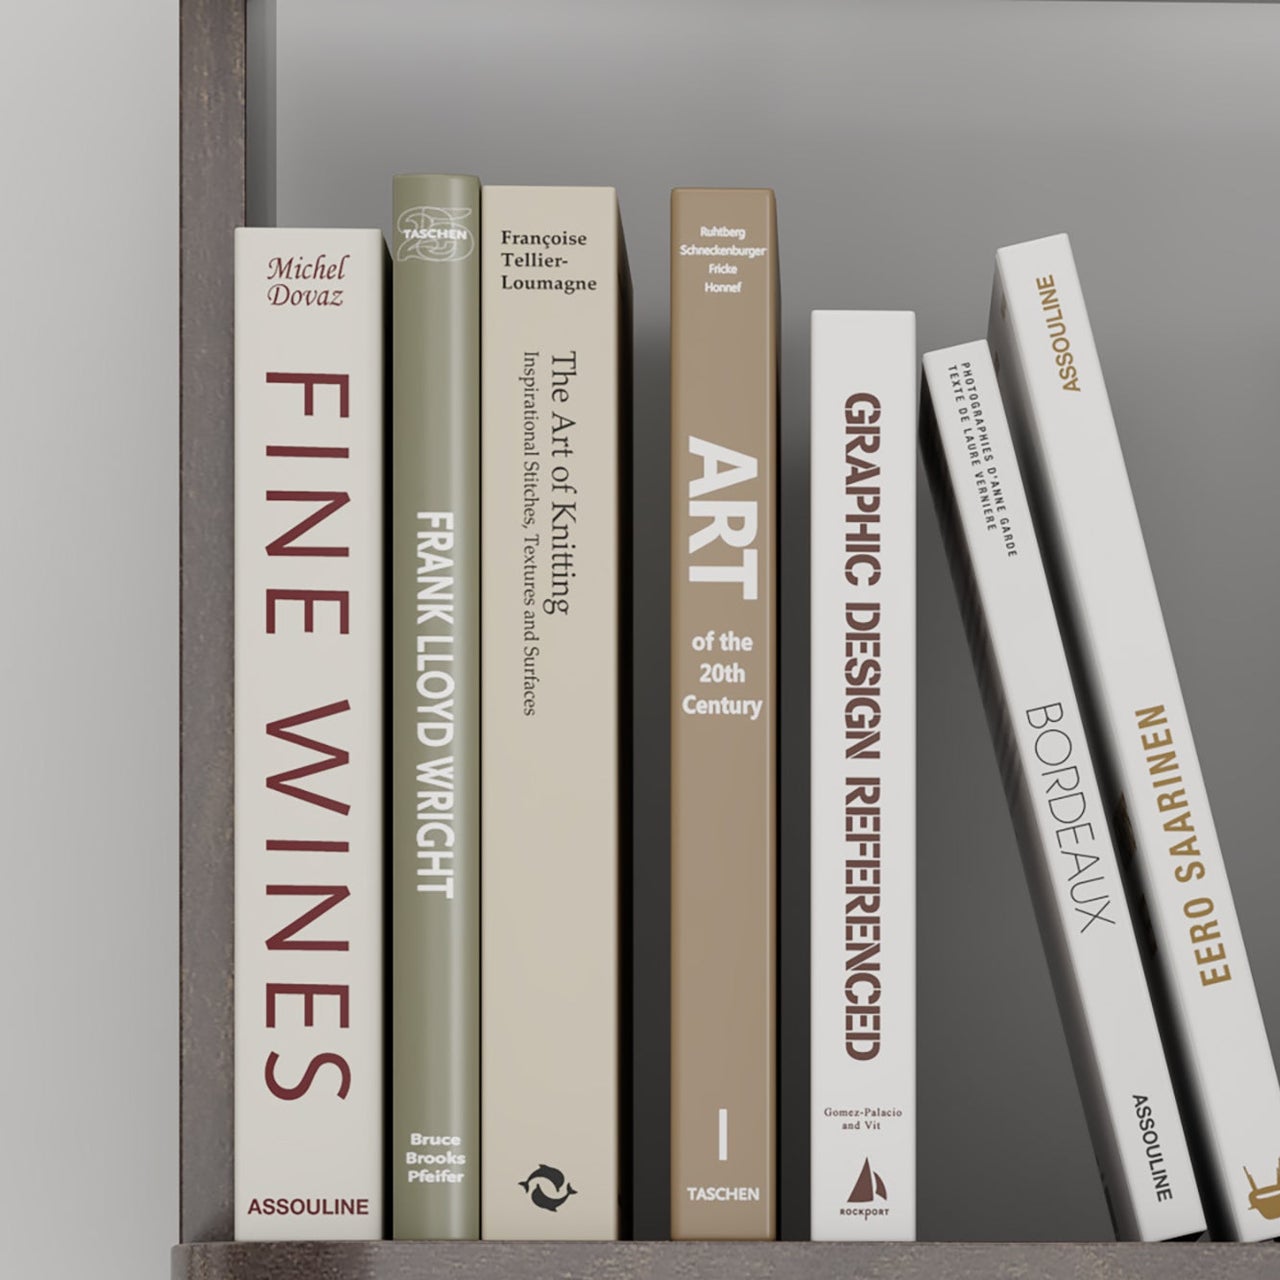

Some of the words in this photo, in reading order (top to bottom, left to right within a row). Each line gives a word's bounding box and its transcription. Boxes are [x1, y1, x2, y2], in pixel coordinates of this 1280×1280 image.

[403, 228, 467, 240] TASCHEN
[501, 230, 587, 249] Françoise
[267, 255, 350, 280] Michel
[500, 252, 568, 268] Tellier-
[708, 263, 738, 274] Fricke
[267, 283, 344, 307] Dovaz
[501, 274, 597, 295] Loumagne
[704, 281, 742, 293] Honnef
[1036, 274, 1081, 393] ASSOULINE
[551, 350, 577, 403] The
[948, 364, 965, 402] TEXTE
[518, 351, 540, 456] Inspirational
[958, 407, 970, 422] DE
[551, 411, 577, 458] Art
[963, 428, 981, 466] LAURE
[961, 361, 994, 462] PHOTOGRAPHIES
[987, 467, 1006, 511] D'ANNE
[999, 518, 1018, 557] GARDE
[521, 461, 540, 529] Stitches,
[551, 466, 578, 495] of
[844, 392, 882, 587] GRAPHIC
[974, 472, 997, 531] VERNIERE
[264, 371, 351, 635] FINE
[688, 435, 758, 601] ART
[416, 511, 455, 626] FRANK
[523, 533, 540, 606] Textures
[542, 501, 577, 615] Knitting
[523, 610, 540, 642] and
[691, 631, 716, 652] of
[718, 631, 754, 652] the
[416, 634, 455, 749] LLOYD
[523, 646, 540, 717] Surfaces
[699, 662, 746, 683] 20th
[844, 602, 882, 760] DESIGN
[681, 694, 764, 721] Century
[1134, 704, 1207, 883] SAARINEN
[416, 757, 455, 900] WRIGHT
[1025, 702, 1116, 934] BORDEAUX
[264, 699, 352, 1101] WINES
[844, 776, 882, 1062] REFERENCED
[1180, 895, 1234, 987] EERO
[824, 1107, 903, 1117] Gomez-Palacio
[842, 1121, 861, 1130] and
[865, 1121, 881, 1130] Vit
[406, 1149, 467, 1167] Brooks
[410, 1130, 462, 1148] Bruce
[1131, 1092, 1173, 1203] ASSOULINE
[408, 1167, 465, 1185] Pfeifer
[686, 1186, 760, 1201] TASCHEN
[247, 1198, 369, 1216] ASSOULINE
